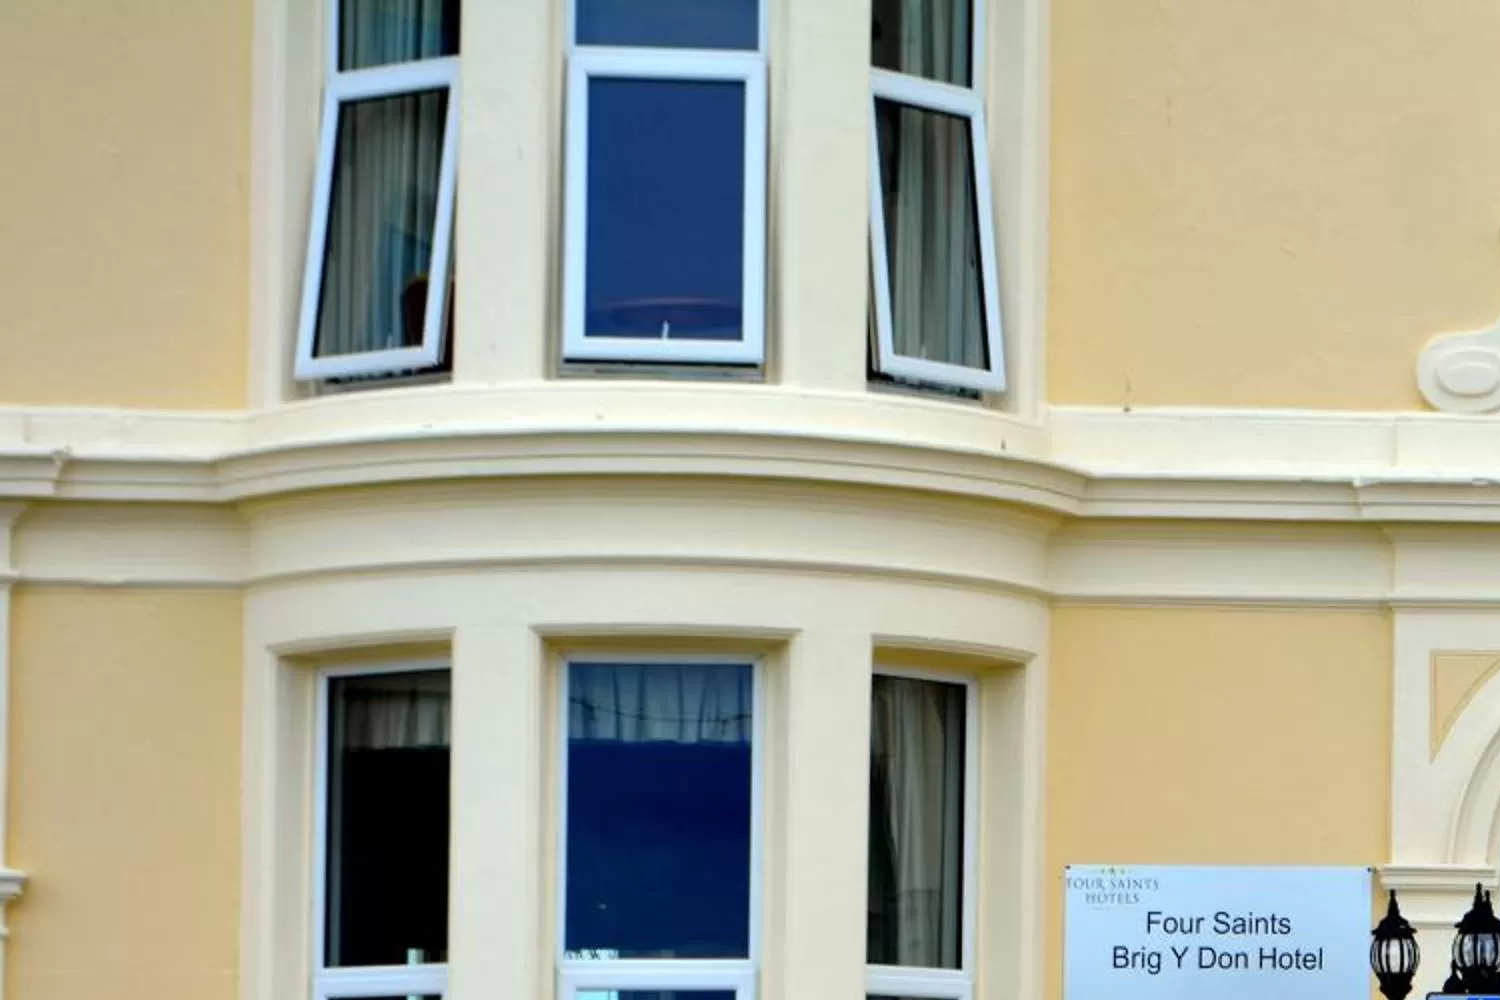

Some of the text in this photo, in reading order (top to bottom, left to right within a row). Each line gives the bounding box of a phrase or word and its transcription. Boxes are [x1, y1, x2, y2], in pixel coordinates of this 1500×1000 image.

[1109, 878, 1160, 891] SAINTS
[1085, 893, 1140, 905] HOTELS
[1146, 911, 1291, 935] Four Saints
[1112, 946, 1323, 974] Brig Y Don Hotel
